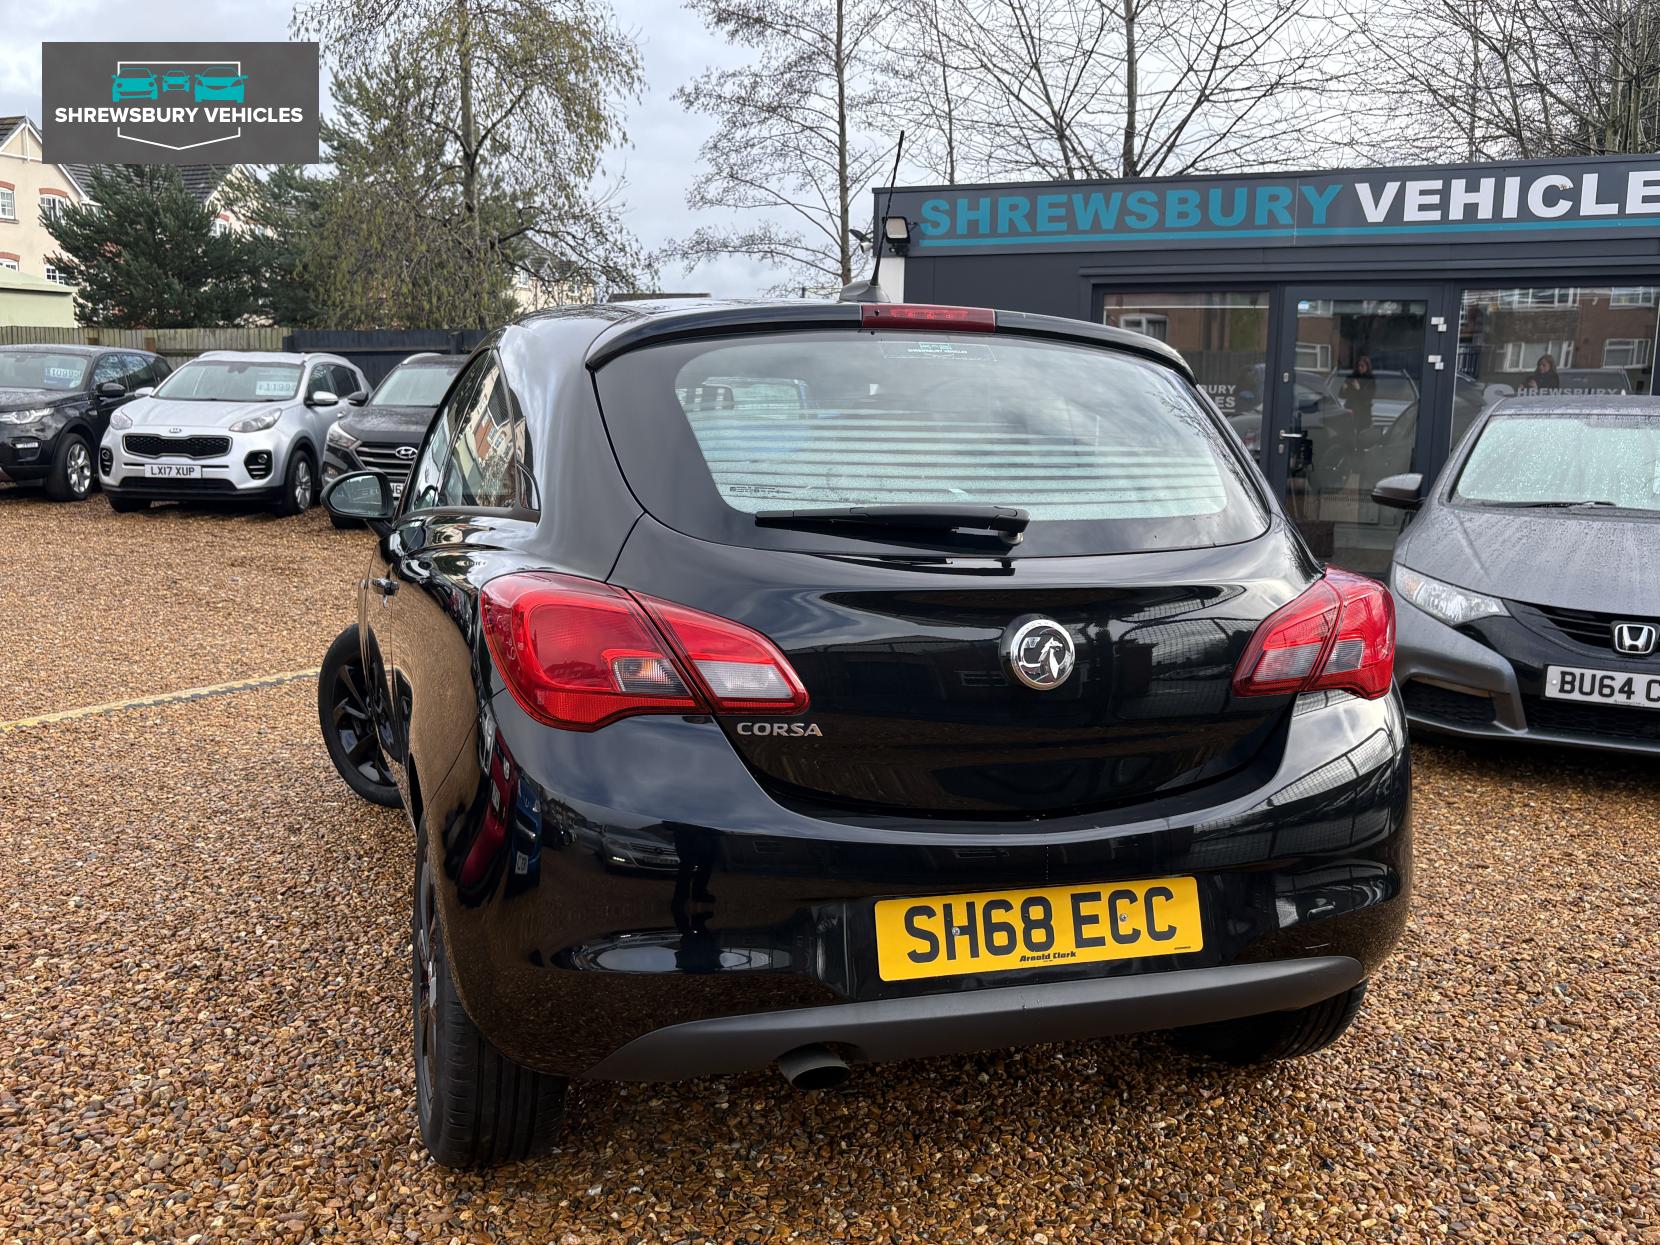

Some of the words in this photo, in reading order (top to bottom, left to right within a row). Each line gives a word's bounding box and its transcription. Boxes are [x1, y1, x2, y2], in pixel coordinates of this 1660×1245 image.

[920, 184, 1343, 235] SHREWSBURY
[150, 466, 172, 476] LX17
[175, 466, 195, 476] XUP
[1559, 671, 1635, 700] BU64
[736, 722, 824, 737] CORSA
[903, 896, 1056, 964] SH68
[1070, 886, 1179, 949] ECC
[1019, 953, 1051, 962] Arnold
[1052, 950, 1077, 960] Clark
